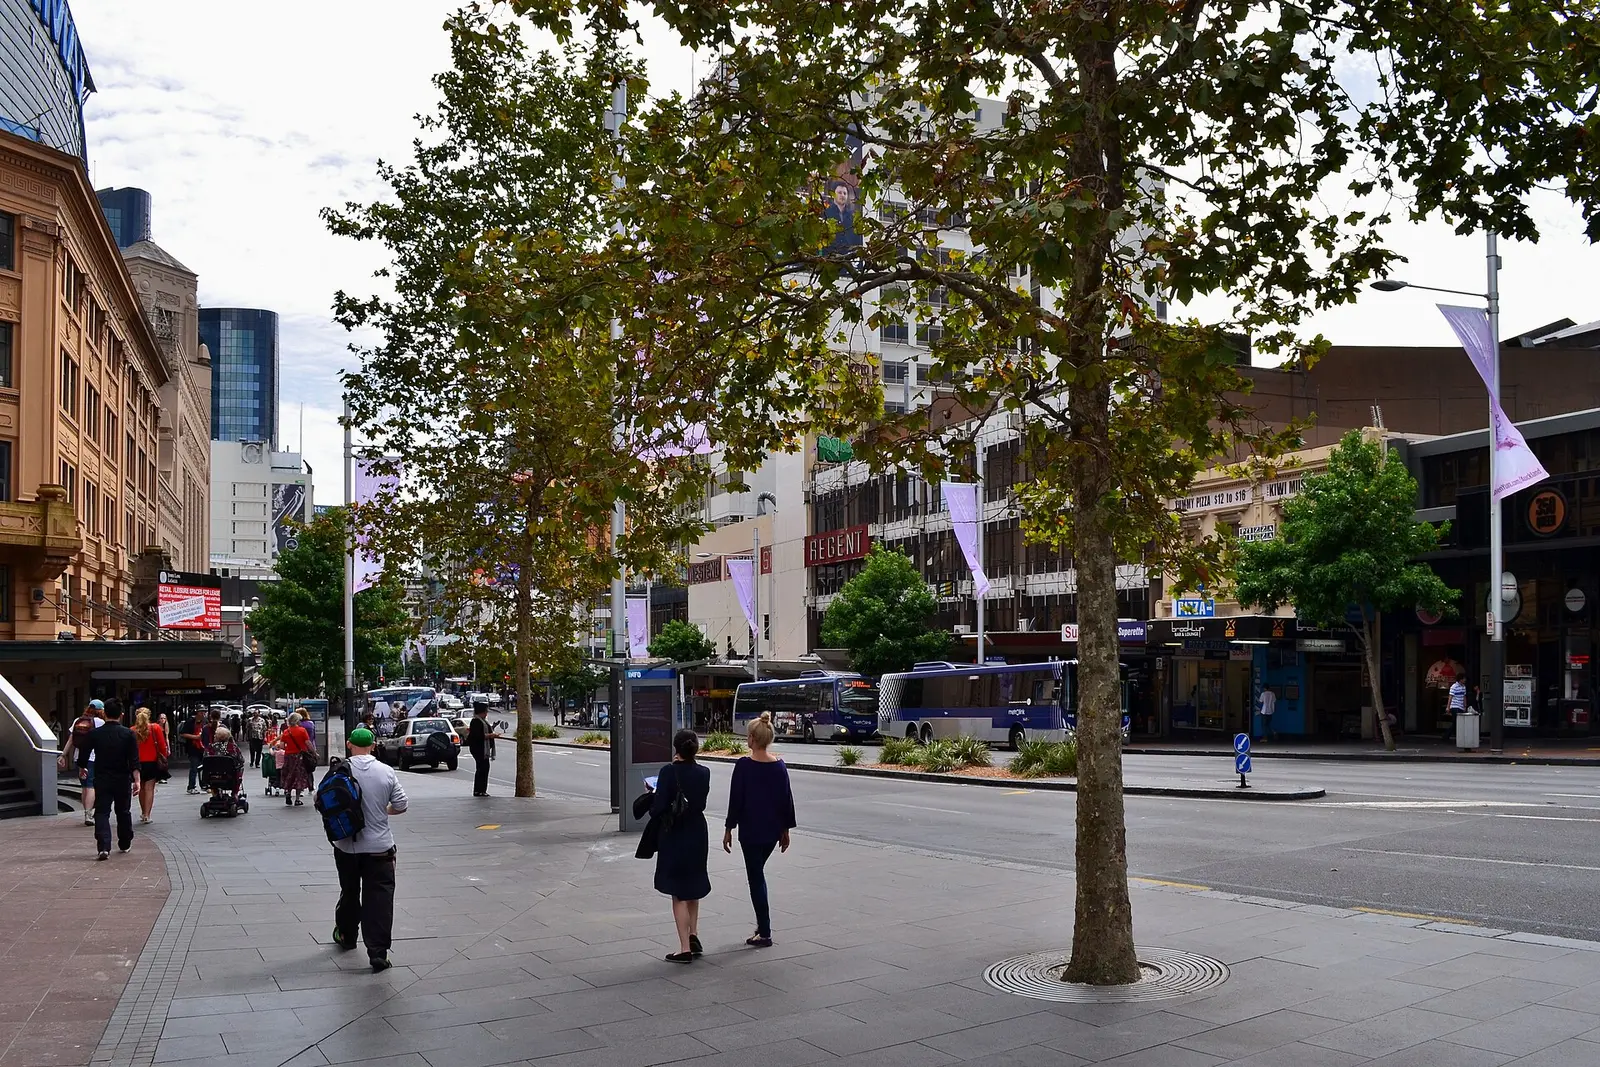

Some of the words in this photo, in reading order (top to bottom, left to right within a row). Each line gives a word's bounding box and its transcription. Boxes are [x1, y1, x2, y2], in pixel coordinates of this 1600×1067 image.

[1269, 482, 1287, 497] KIWI
[1289, 479, 1305, 494] MUS
[1196, 495, 1211, 508] PIZZA
[1214, 493, 1224, 505] $12
[1226, 493, 1233, 504] to
[1235, 489, 1246, 501] $16
[810, 530, 863, 560] REGENT
[1065, 625, 1079, 638] Su
[1118, 627, 1144, 637] Superette
[1296, 620, 1337, 638] broolyn
